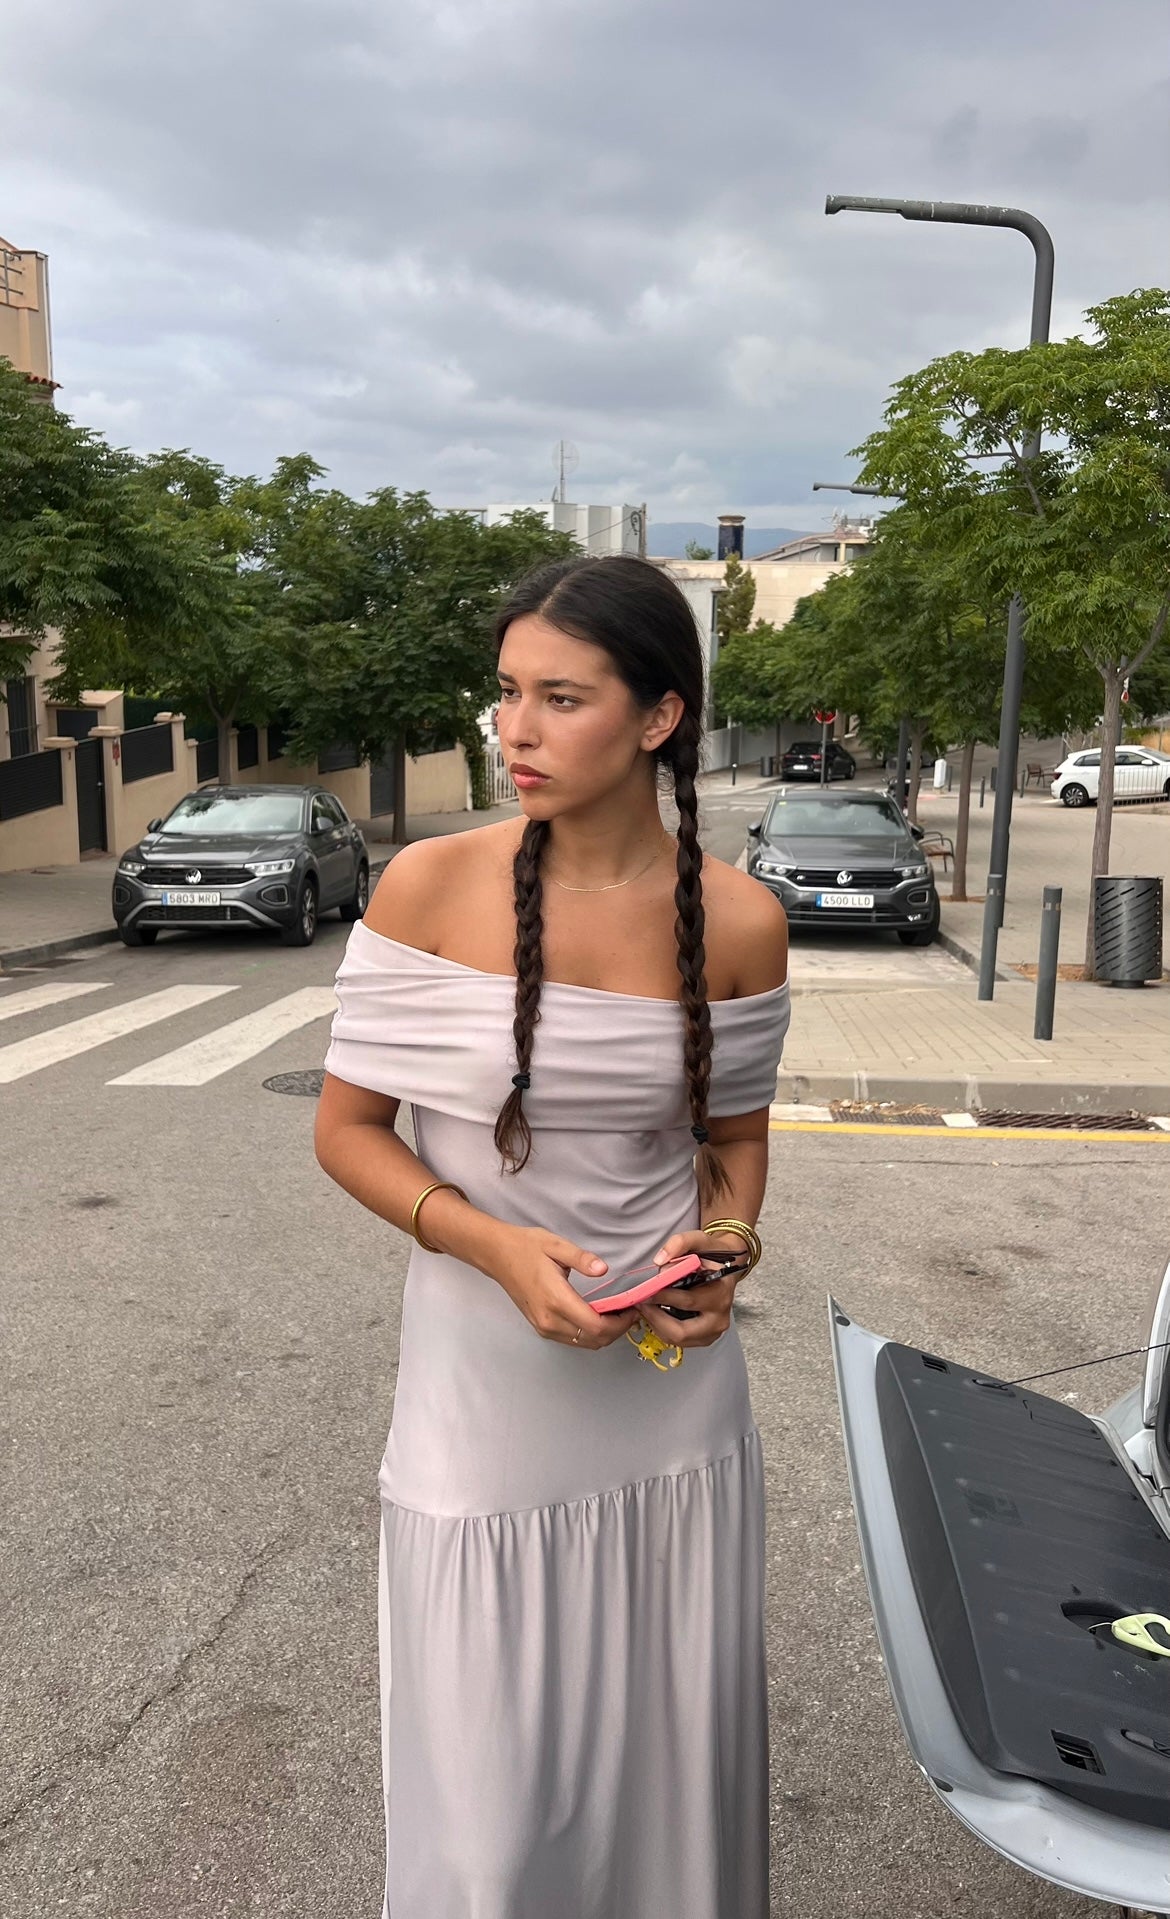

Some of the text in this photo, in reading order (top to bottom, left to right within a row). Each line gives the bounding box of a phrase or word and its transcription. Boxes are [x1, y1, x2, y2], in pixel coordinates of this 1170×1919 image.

[170, 893, 195, 904] 5803
[823, 895, 871, 906] 4500 LLD
